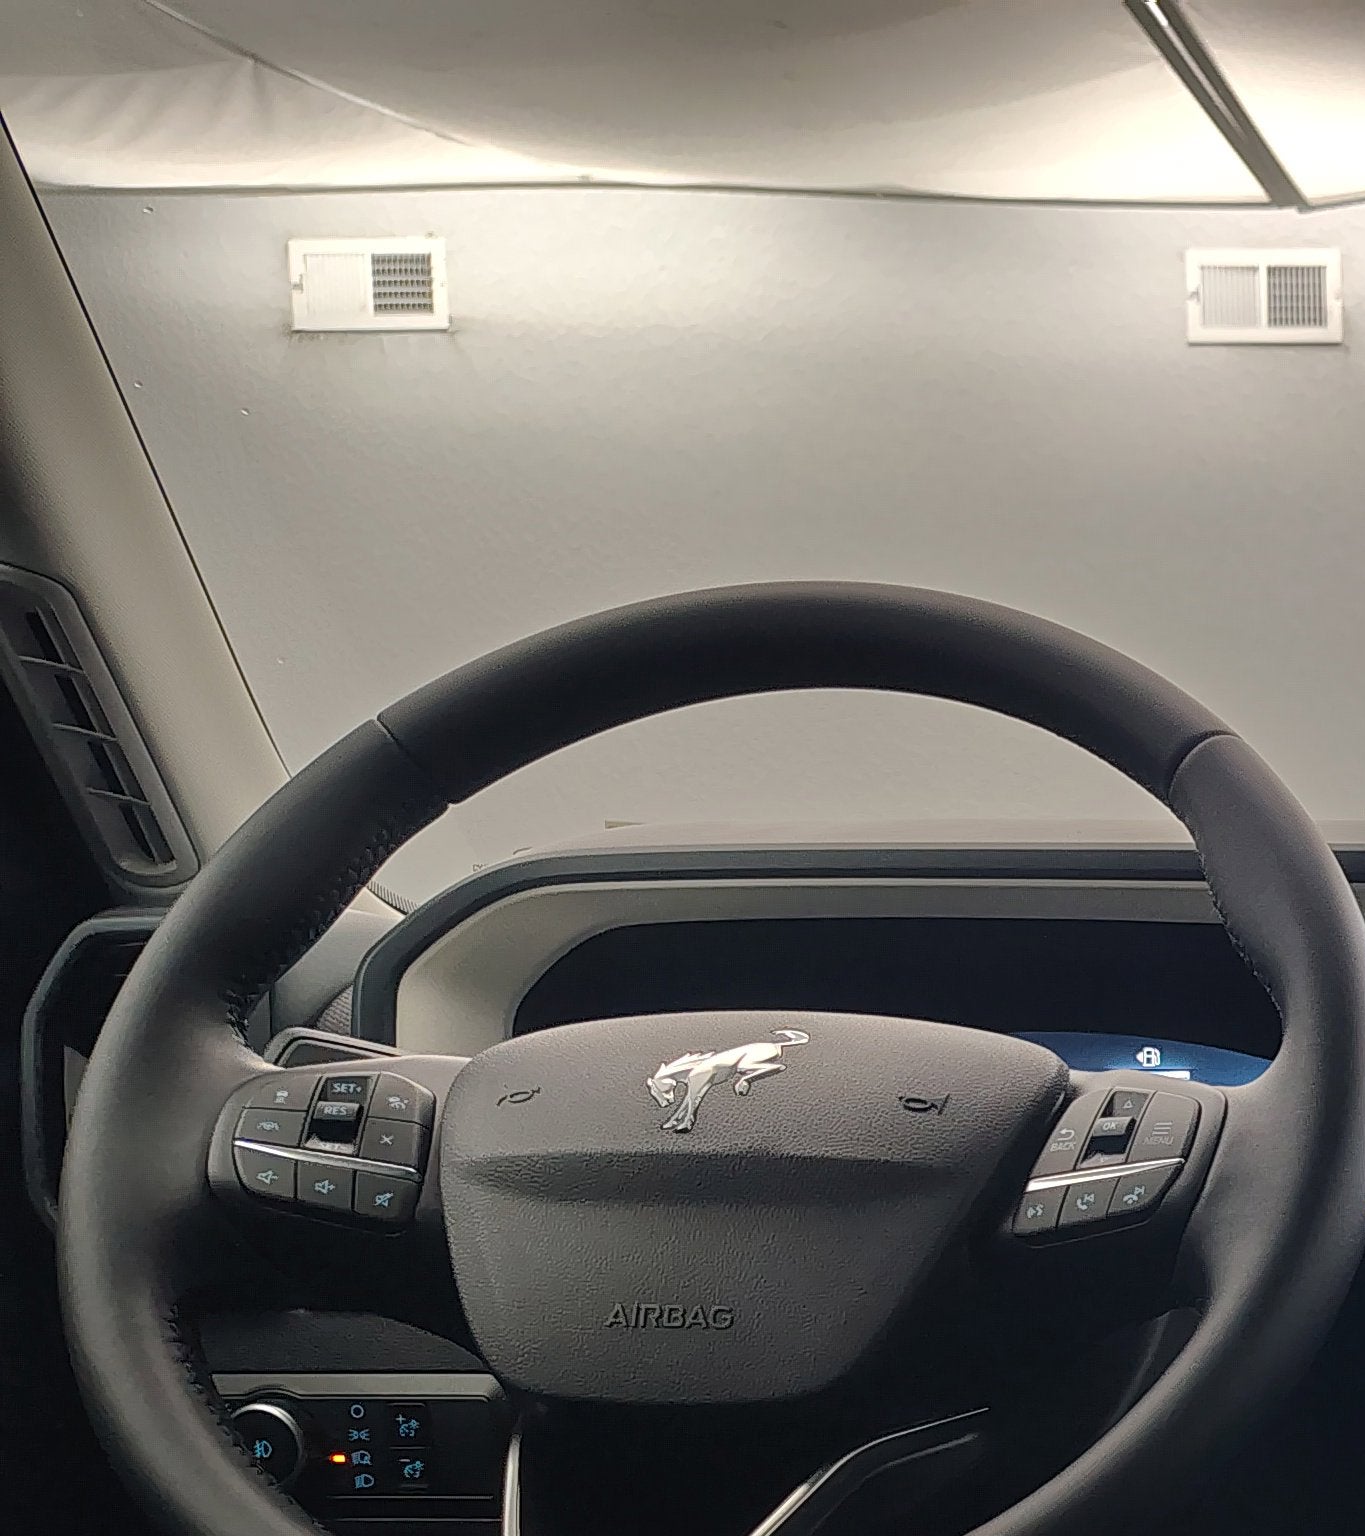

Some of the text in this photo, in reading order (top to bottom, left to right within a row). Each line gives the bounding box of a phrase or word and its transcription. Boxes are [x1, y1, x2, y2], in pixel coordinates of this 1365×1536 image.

[324, 1105, 347, 1116] RES
[1102, 1122, 1118, 1131] OK
[1143, 1137, 1174, 1146] MENU
[1051, 1142, 1076, 1152] BACK
[603, 1301, 735, 1330] AIRBAG
